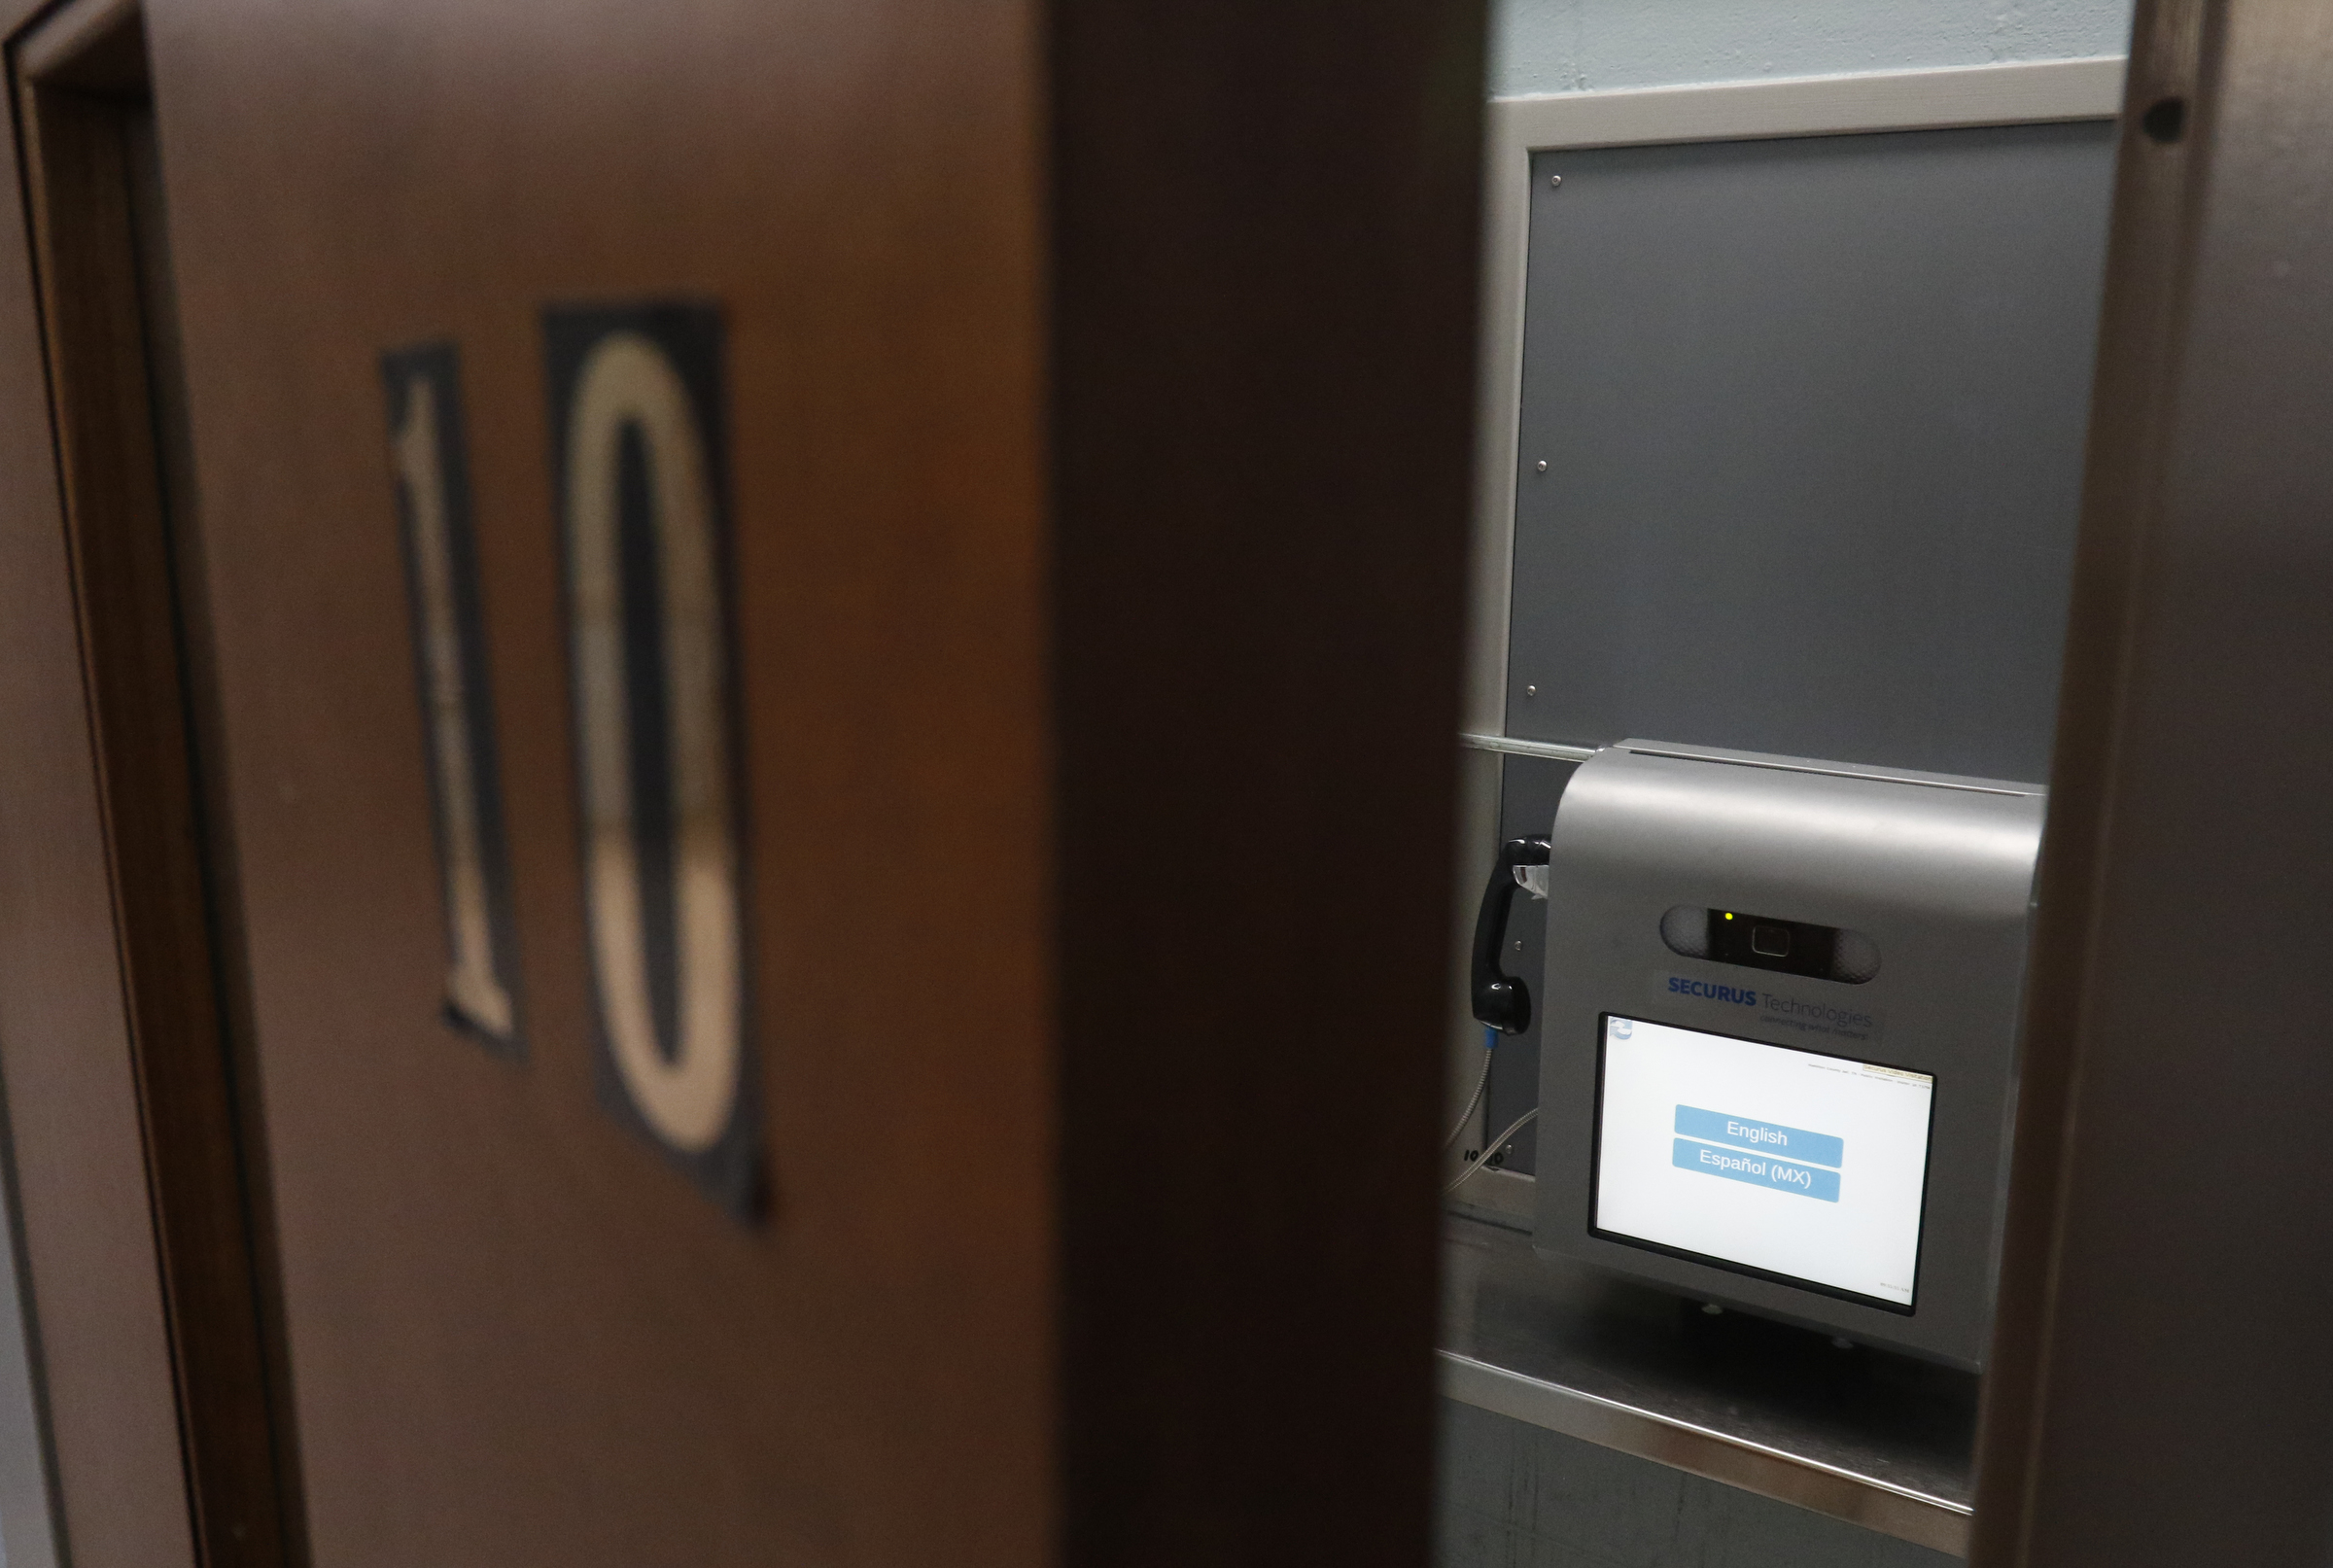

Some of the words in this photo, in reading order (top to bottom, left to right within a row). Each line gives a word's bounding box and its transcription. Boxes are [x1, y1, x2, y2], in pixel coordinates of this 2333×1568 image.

[397, 329, 742, 1155] 10
[1668, 976, 1758, 1007] SECURUS
[1761, 993, 1873, 1028] Technologies
[1759, 1015, 1807, 1032] connecting
[1808, 1022, 1830, 1036] what
[1726, 1120, 1789, 1147] English
[1699, 1148, 1767, 1176] Español
[1771, 1164, 1812, 1190] (MX)
